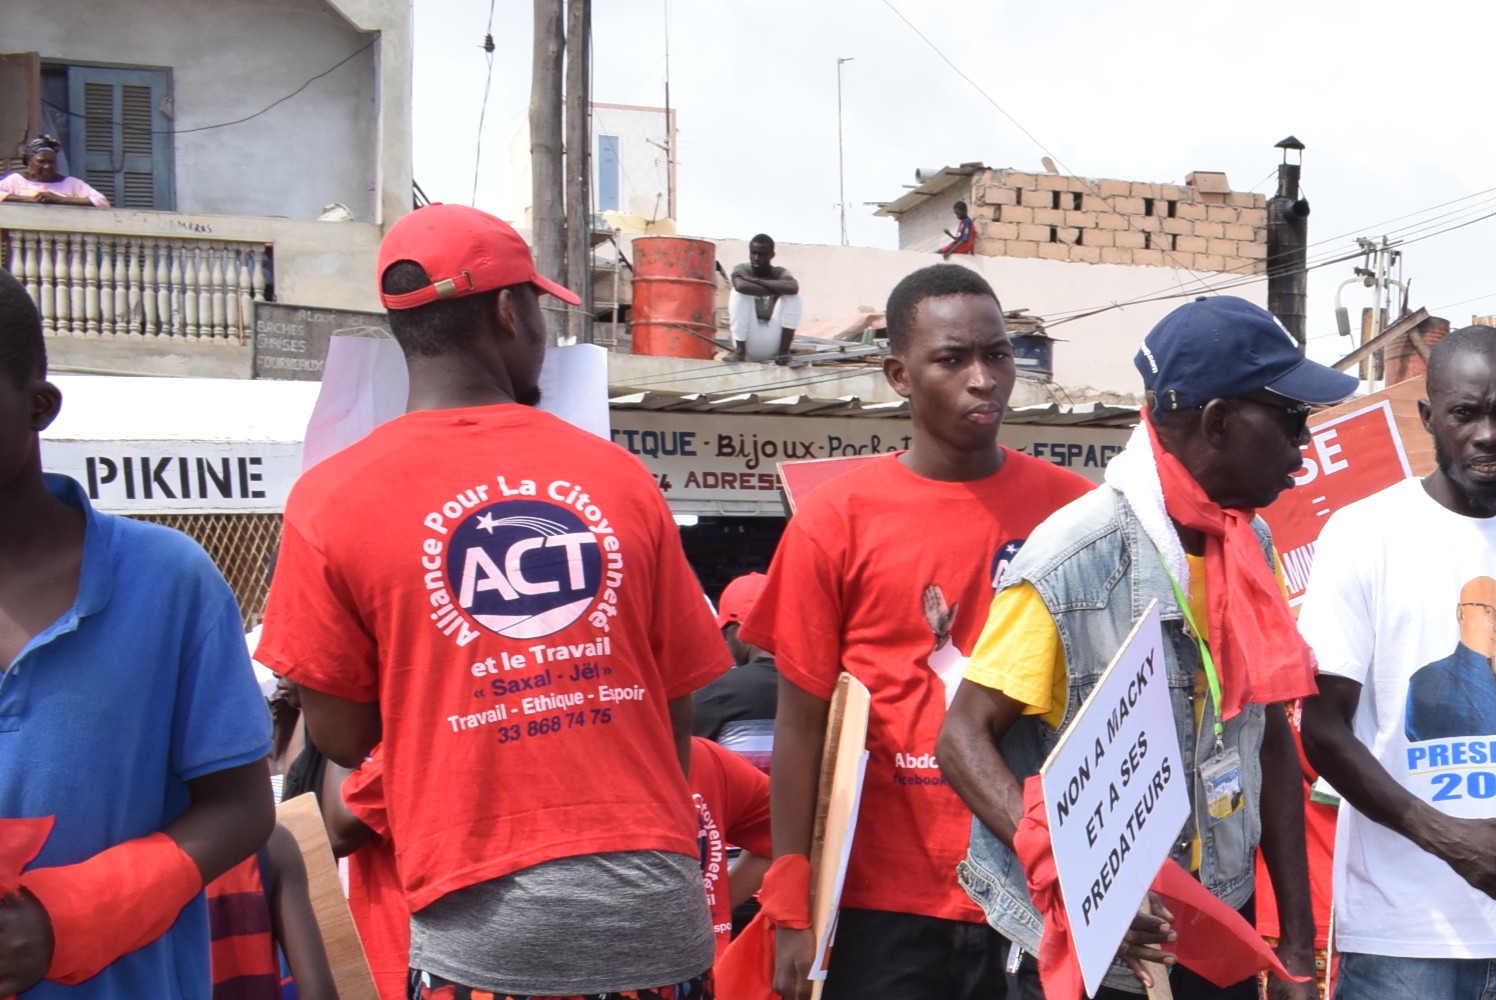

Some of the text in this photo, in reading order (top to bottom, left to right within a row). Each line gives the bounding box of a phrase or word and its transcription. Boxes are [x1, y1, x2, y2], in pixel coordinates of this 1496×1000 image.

[86, 457, 266, 499] PIKINE
[497, 476, 536, 497] La
[424, 484, 489, 534] Pour
[422, 538, 480, 648] Alliance
[459, 532, 598, 609] ACT
[471, 637, 611, 677] et le Travail
[491, 669, 551, 697] Saxal
[448, 685, 645, 733] Travail Ethique Espoir
[498, 708, 613, 744] 33 868 74 75
[1056, 648, 1156, 826] NON A MACKY
[1085, 730, 1149, 850] ET A SES
[1081, 756, 1173, 928] PREDATEURS
